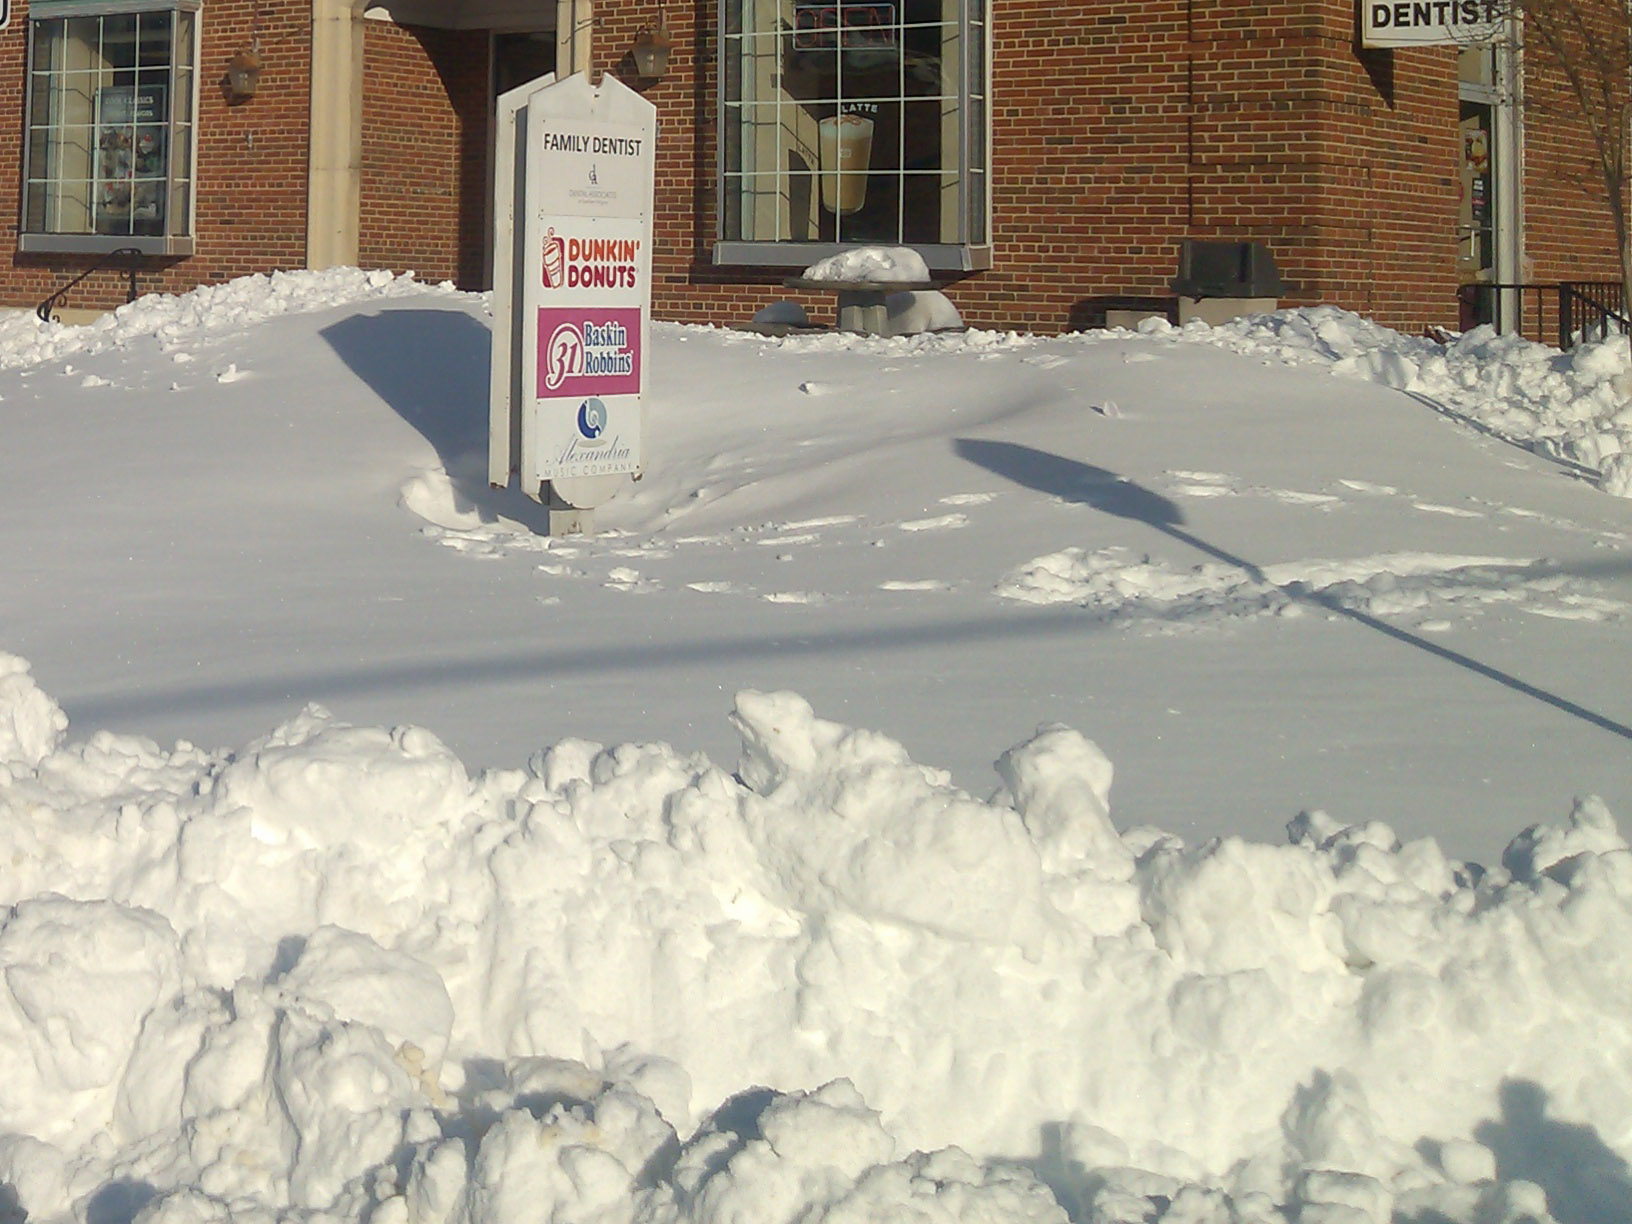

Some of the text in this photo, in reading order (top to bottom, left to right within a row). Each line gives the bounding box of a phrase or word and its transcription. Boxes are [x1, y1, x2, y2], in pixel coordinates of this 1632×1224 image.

[841, 103, 879, 114] LATTE
[543, 133, 642, 157] FAMILY DENTIST
[568, 238, 641, 263] DUNKIN'
[568, 265, 636, 288] DONUTS
[584, 323, 625, 346] Baskin
[547, 342, 578, 387] 31
[585, 350, 632, 374] Robbins
[553, 434, 630, 465] Alexandria
[544, 463, 632, 478] MUSIC COMPANY
